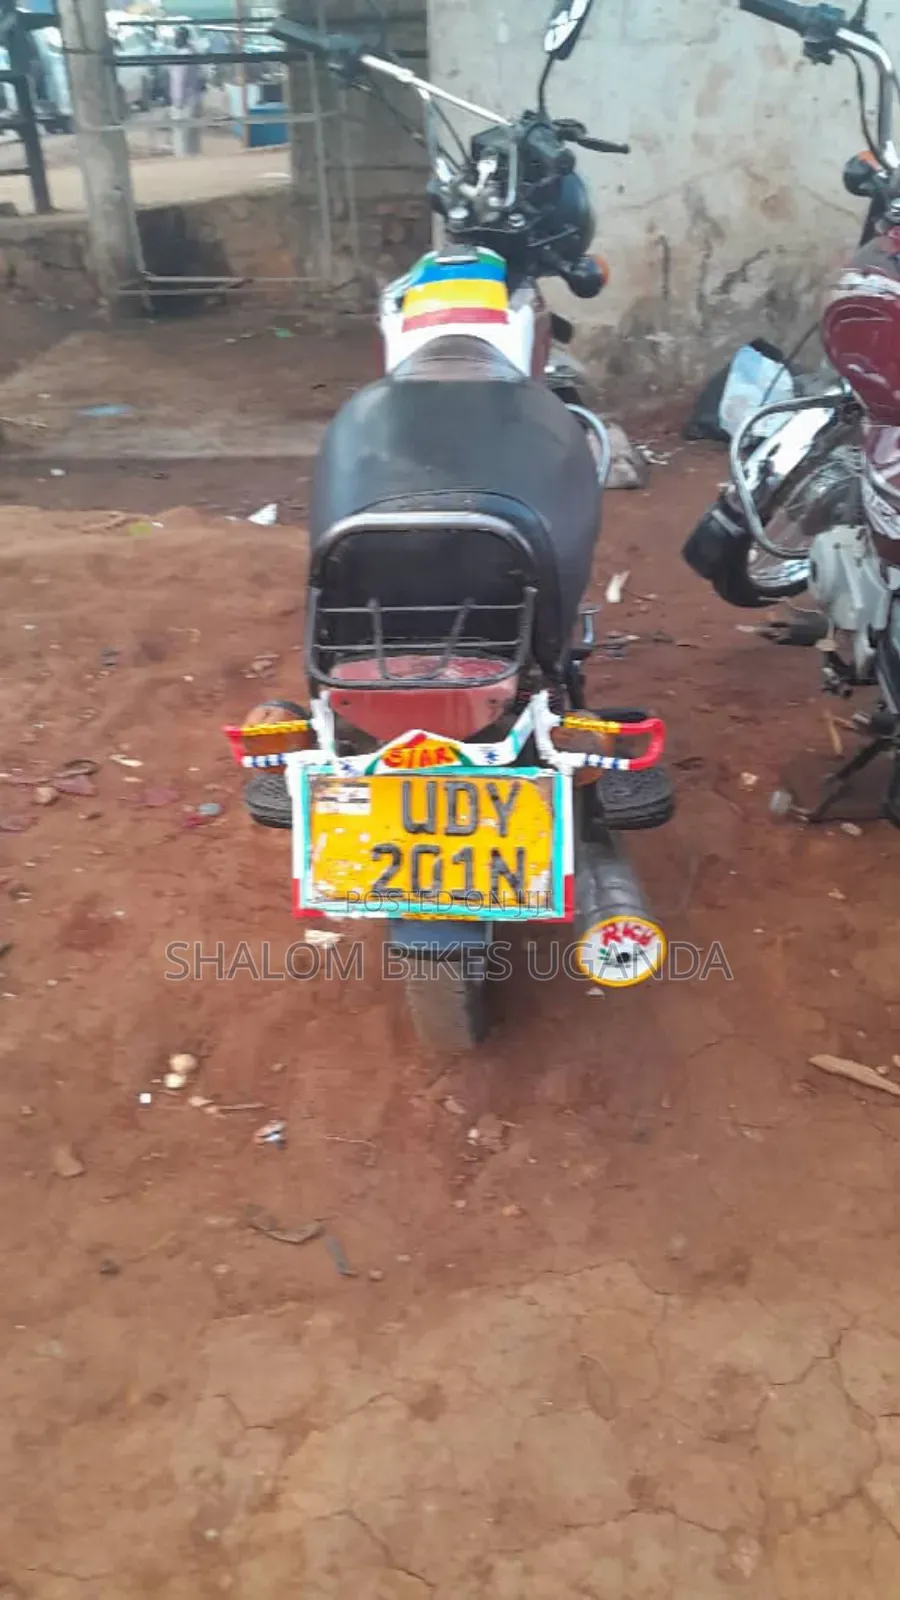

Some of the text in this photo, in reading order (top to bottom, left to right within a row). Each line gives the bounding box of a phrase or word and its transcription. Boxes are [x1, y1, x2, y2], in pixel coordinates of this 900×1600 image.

[383, 747, 456, 769] STAR
[401, 779, 522, 838] UDY
[370, 843, 527, 906] 201N
